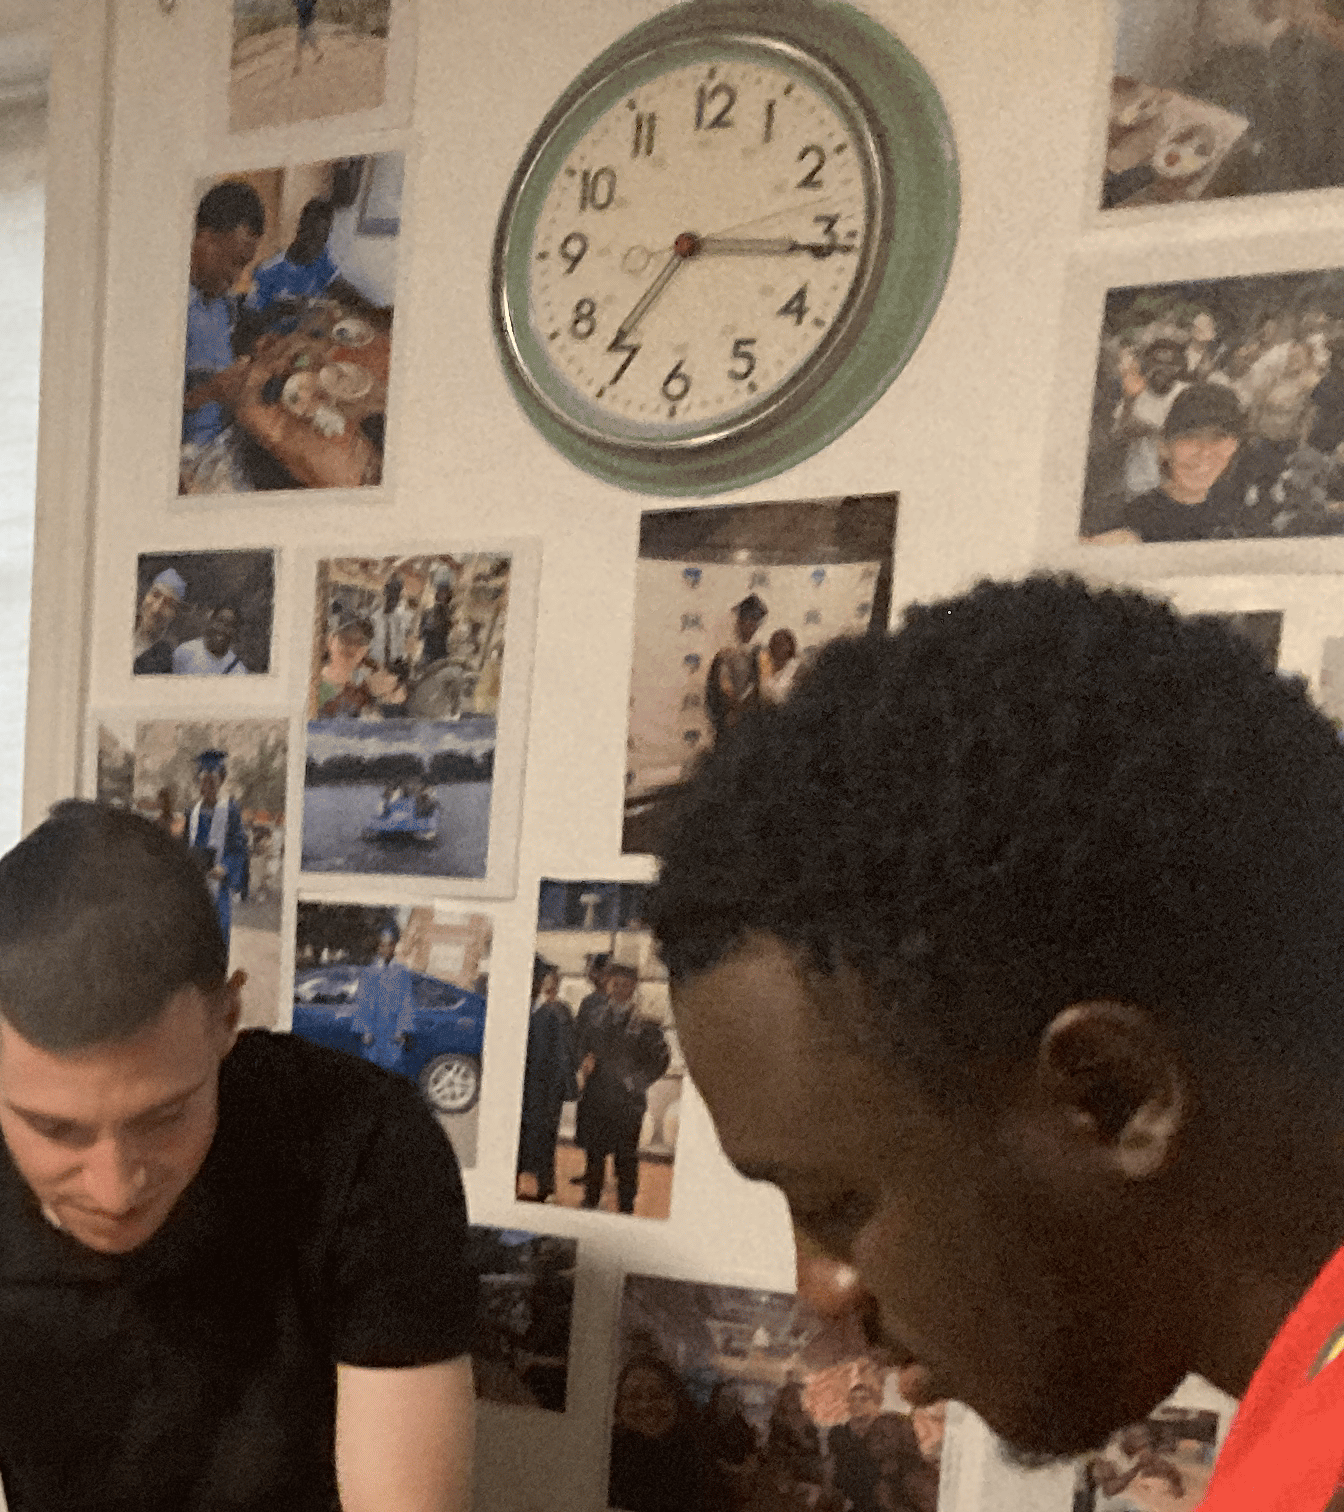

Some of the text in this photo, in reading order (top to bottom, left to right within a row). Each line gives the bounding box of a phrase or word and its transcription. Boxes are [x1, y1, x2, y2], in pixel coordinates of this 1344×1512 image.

[694, 82, 739, 131] 12
[763, 98, 777, 144] 1
[631, 111, 658, 159] 11
[578, 166, 618, 212] 10
[796, 143, 827, 190] 2
[559, 231, 589, 276] 9
[812, 213, 841, 259] 3
[569, 298, 597, 341] 8
[776, 284, 810, 327] 4
[608, 340, 642, 387] 7
[661, 359, 692, 402] 6
[728, 337, 758, 381] 5
